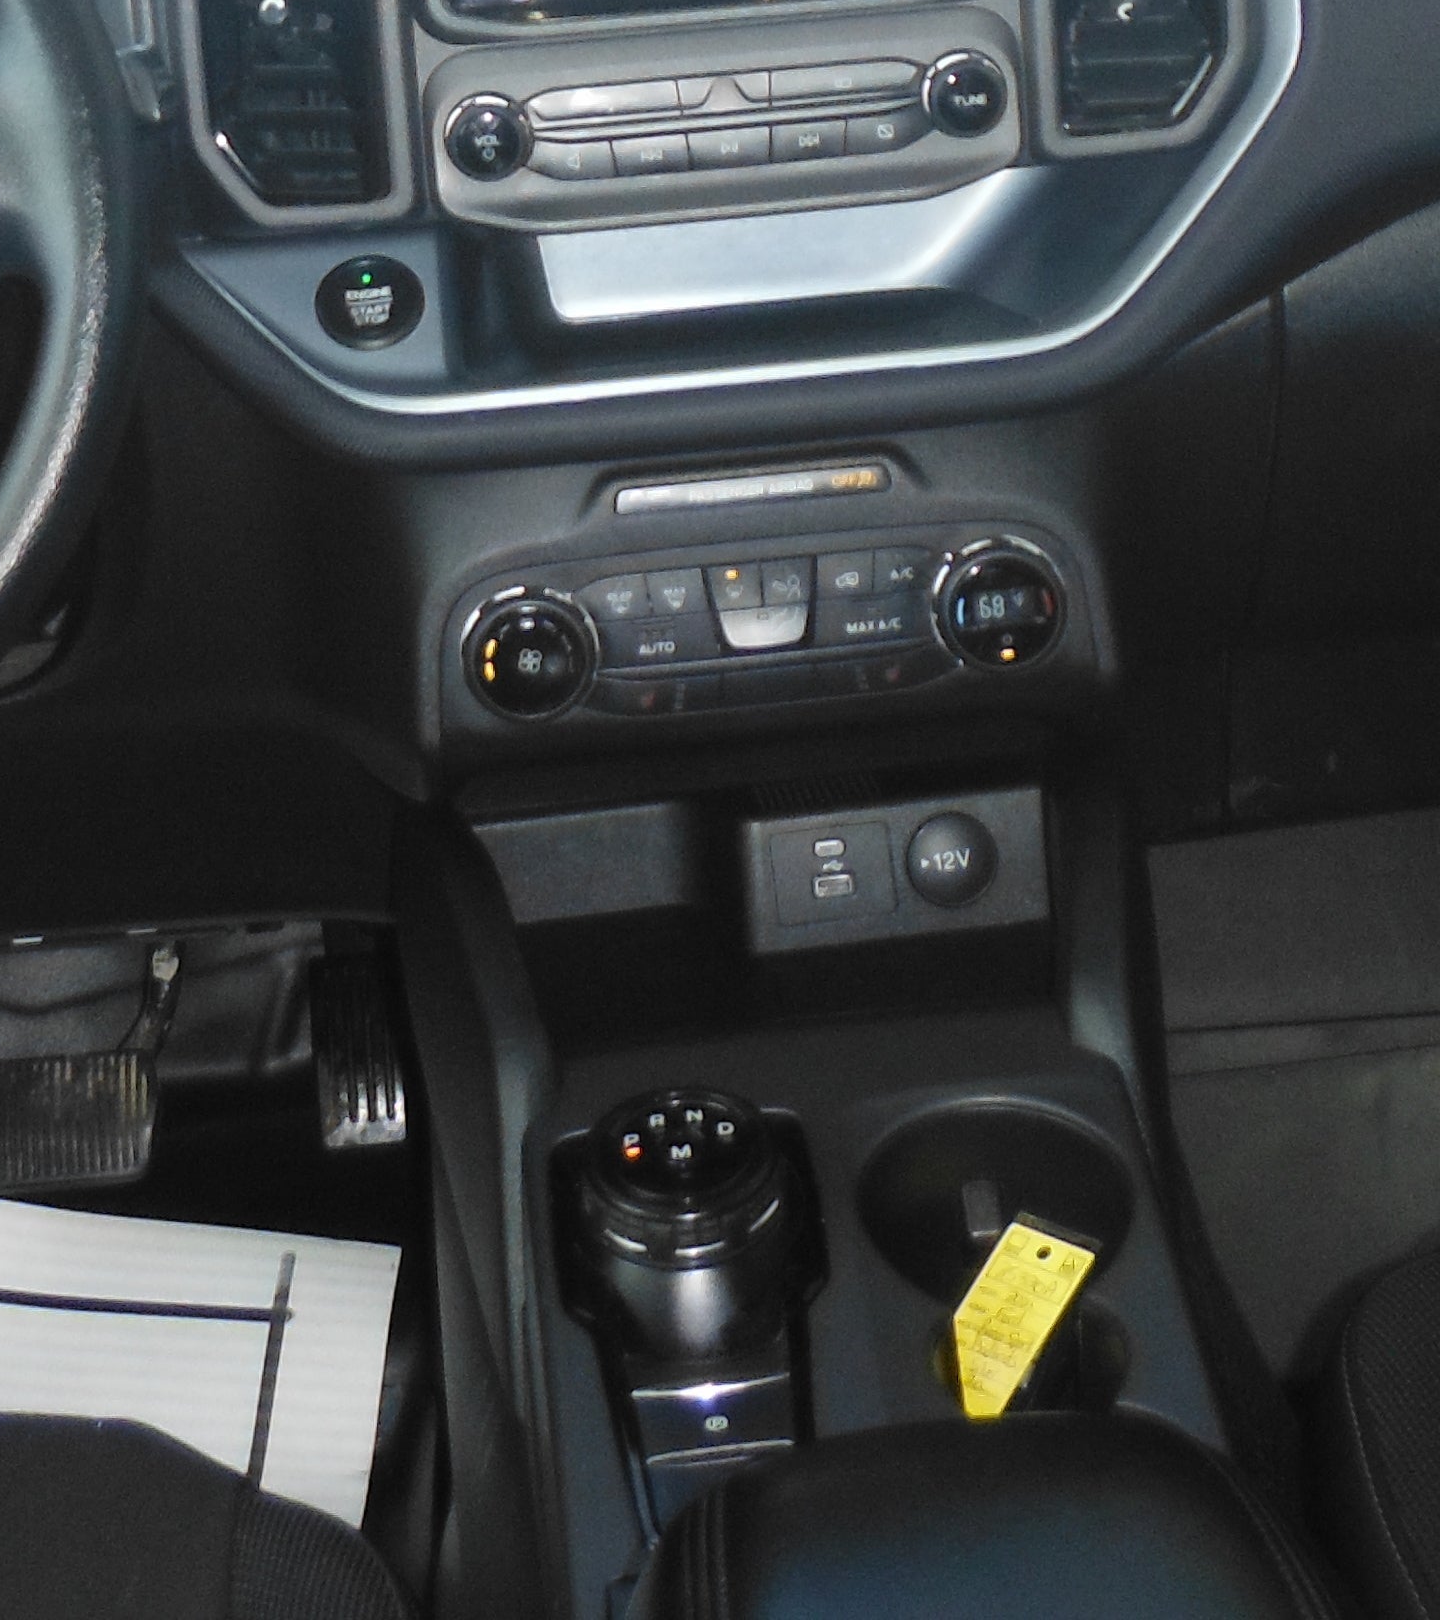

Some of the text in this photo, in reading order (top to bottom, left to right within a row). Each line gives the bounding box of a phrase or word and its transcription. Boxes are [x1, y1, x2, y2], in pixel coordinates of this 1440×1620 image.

[473, 134, 500, 148] VOL
[890, 565, 914, 580] A/C
[978, 594, 1006, 619] 68
[846, 617, 902, 635] MAX A/C
[639, 640, 676, 656] AUTO
[933, 846, 971, 872] 12V
[649, 1113, 666, 1128] R
[685, 1108, 704, 1123] N
[717, 1121, 735, 1136] D
[623, 1133, 640, 1148] P
[671, 1143, 693, 1160] M
